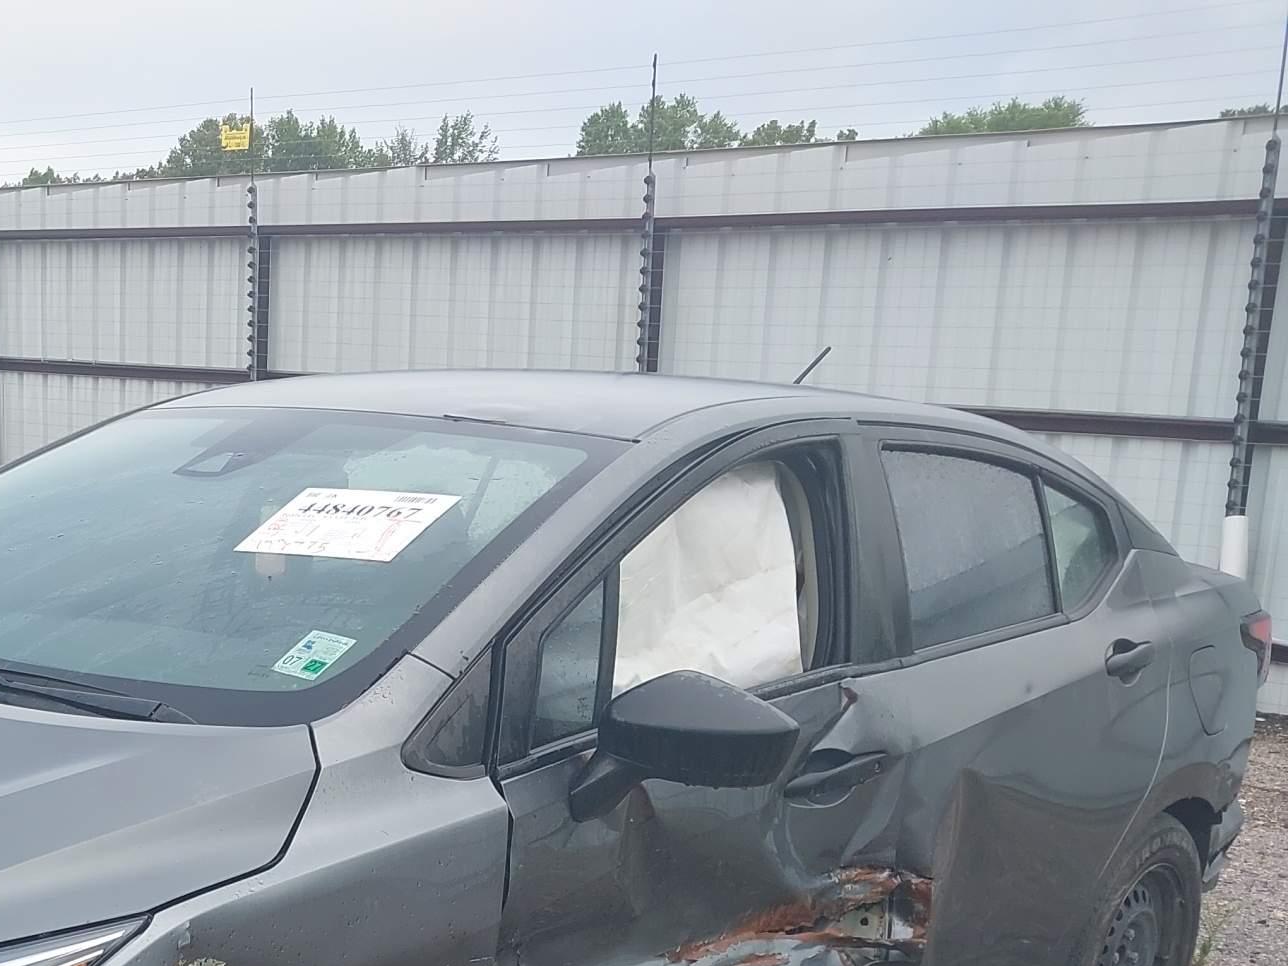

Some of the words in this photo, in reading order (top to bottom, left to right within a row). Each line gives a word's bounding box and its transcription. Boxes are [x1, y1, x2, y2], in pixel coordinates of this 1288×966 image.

[299, 502, 423, 518] 44840767
[283, 654, 303, 666] 07
[305, 660, 324, 672] 27
